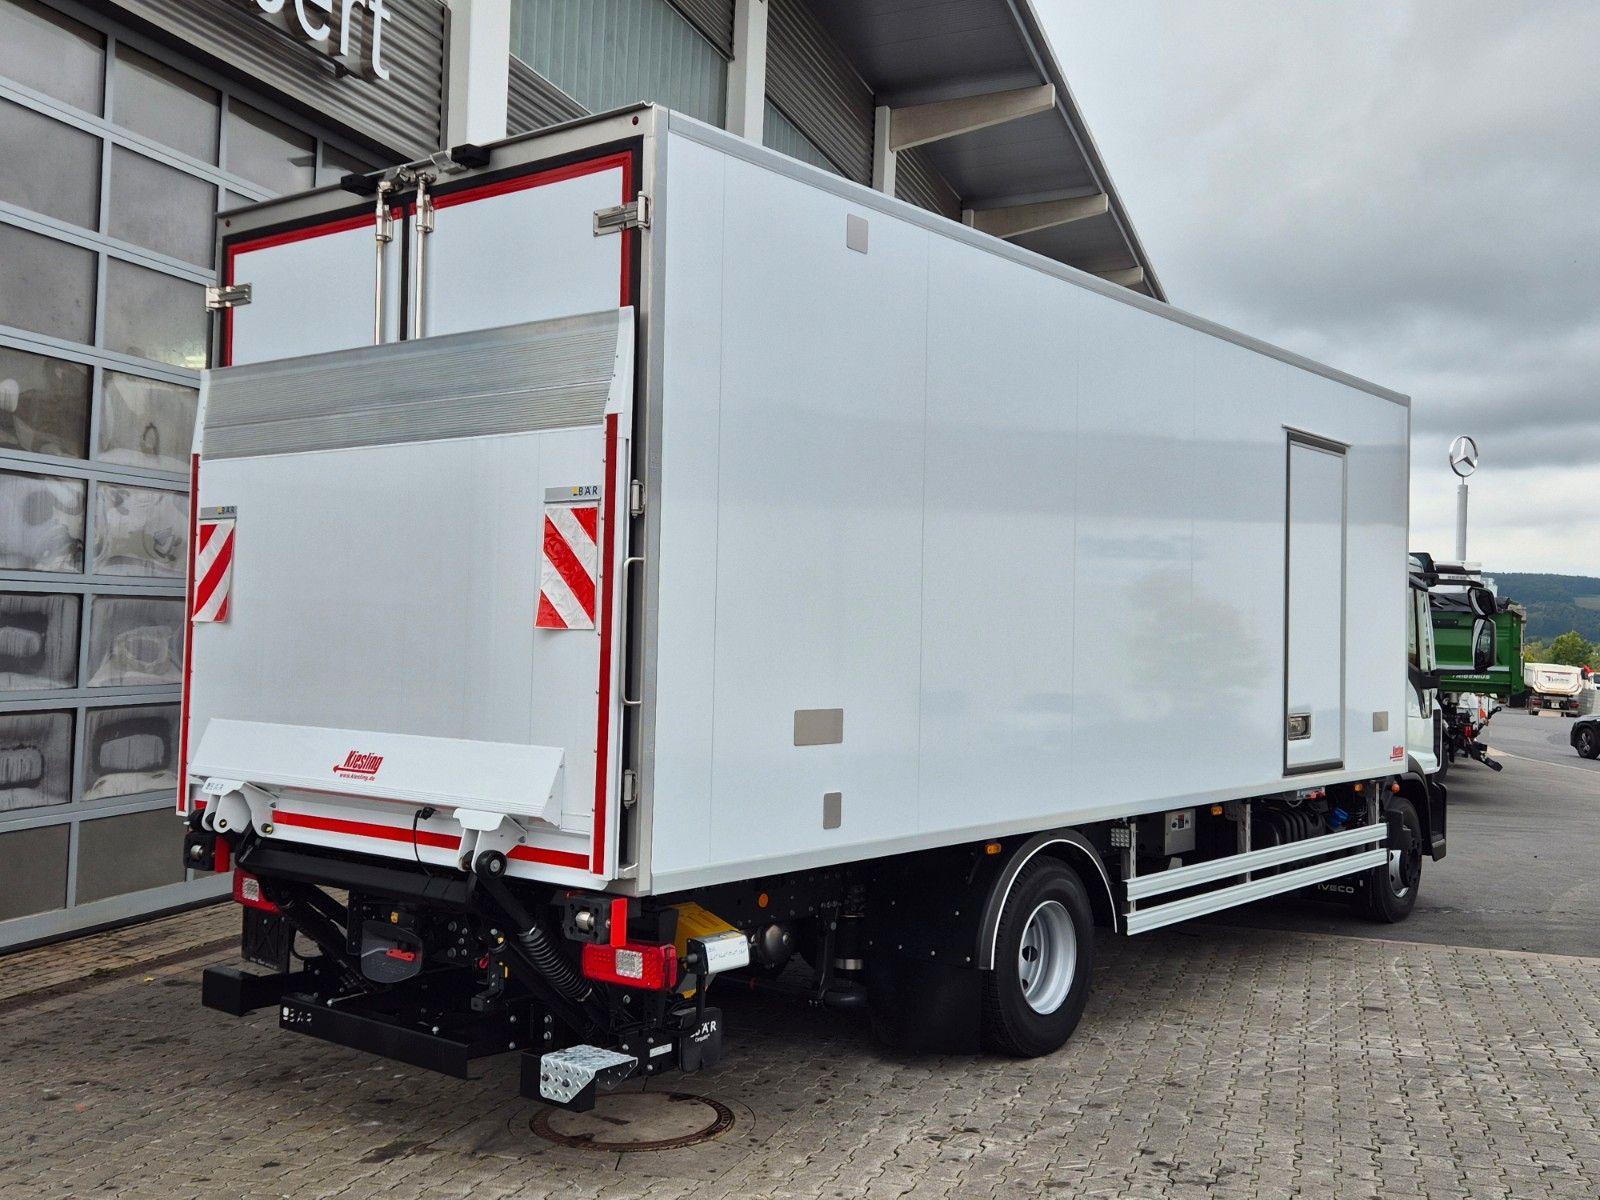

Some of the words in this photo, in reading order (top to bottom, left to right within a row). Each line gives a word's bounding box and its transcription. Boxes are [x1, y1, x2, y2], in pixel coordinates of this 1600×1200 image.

[256, 0, 391, 81] ert
[578, 485, 598, 496] BÄR
[344, 750, 384, 774] Kiesling
[1317, 883, 1355, 894] IVECO
